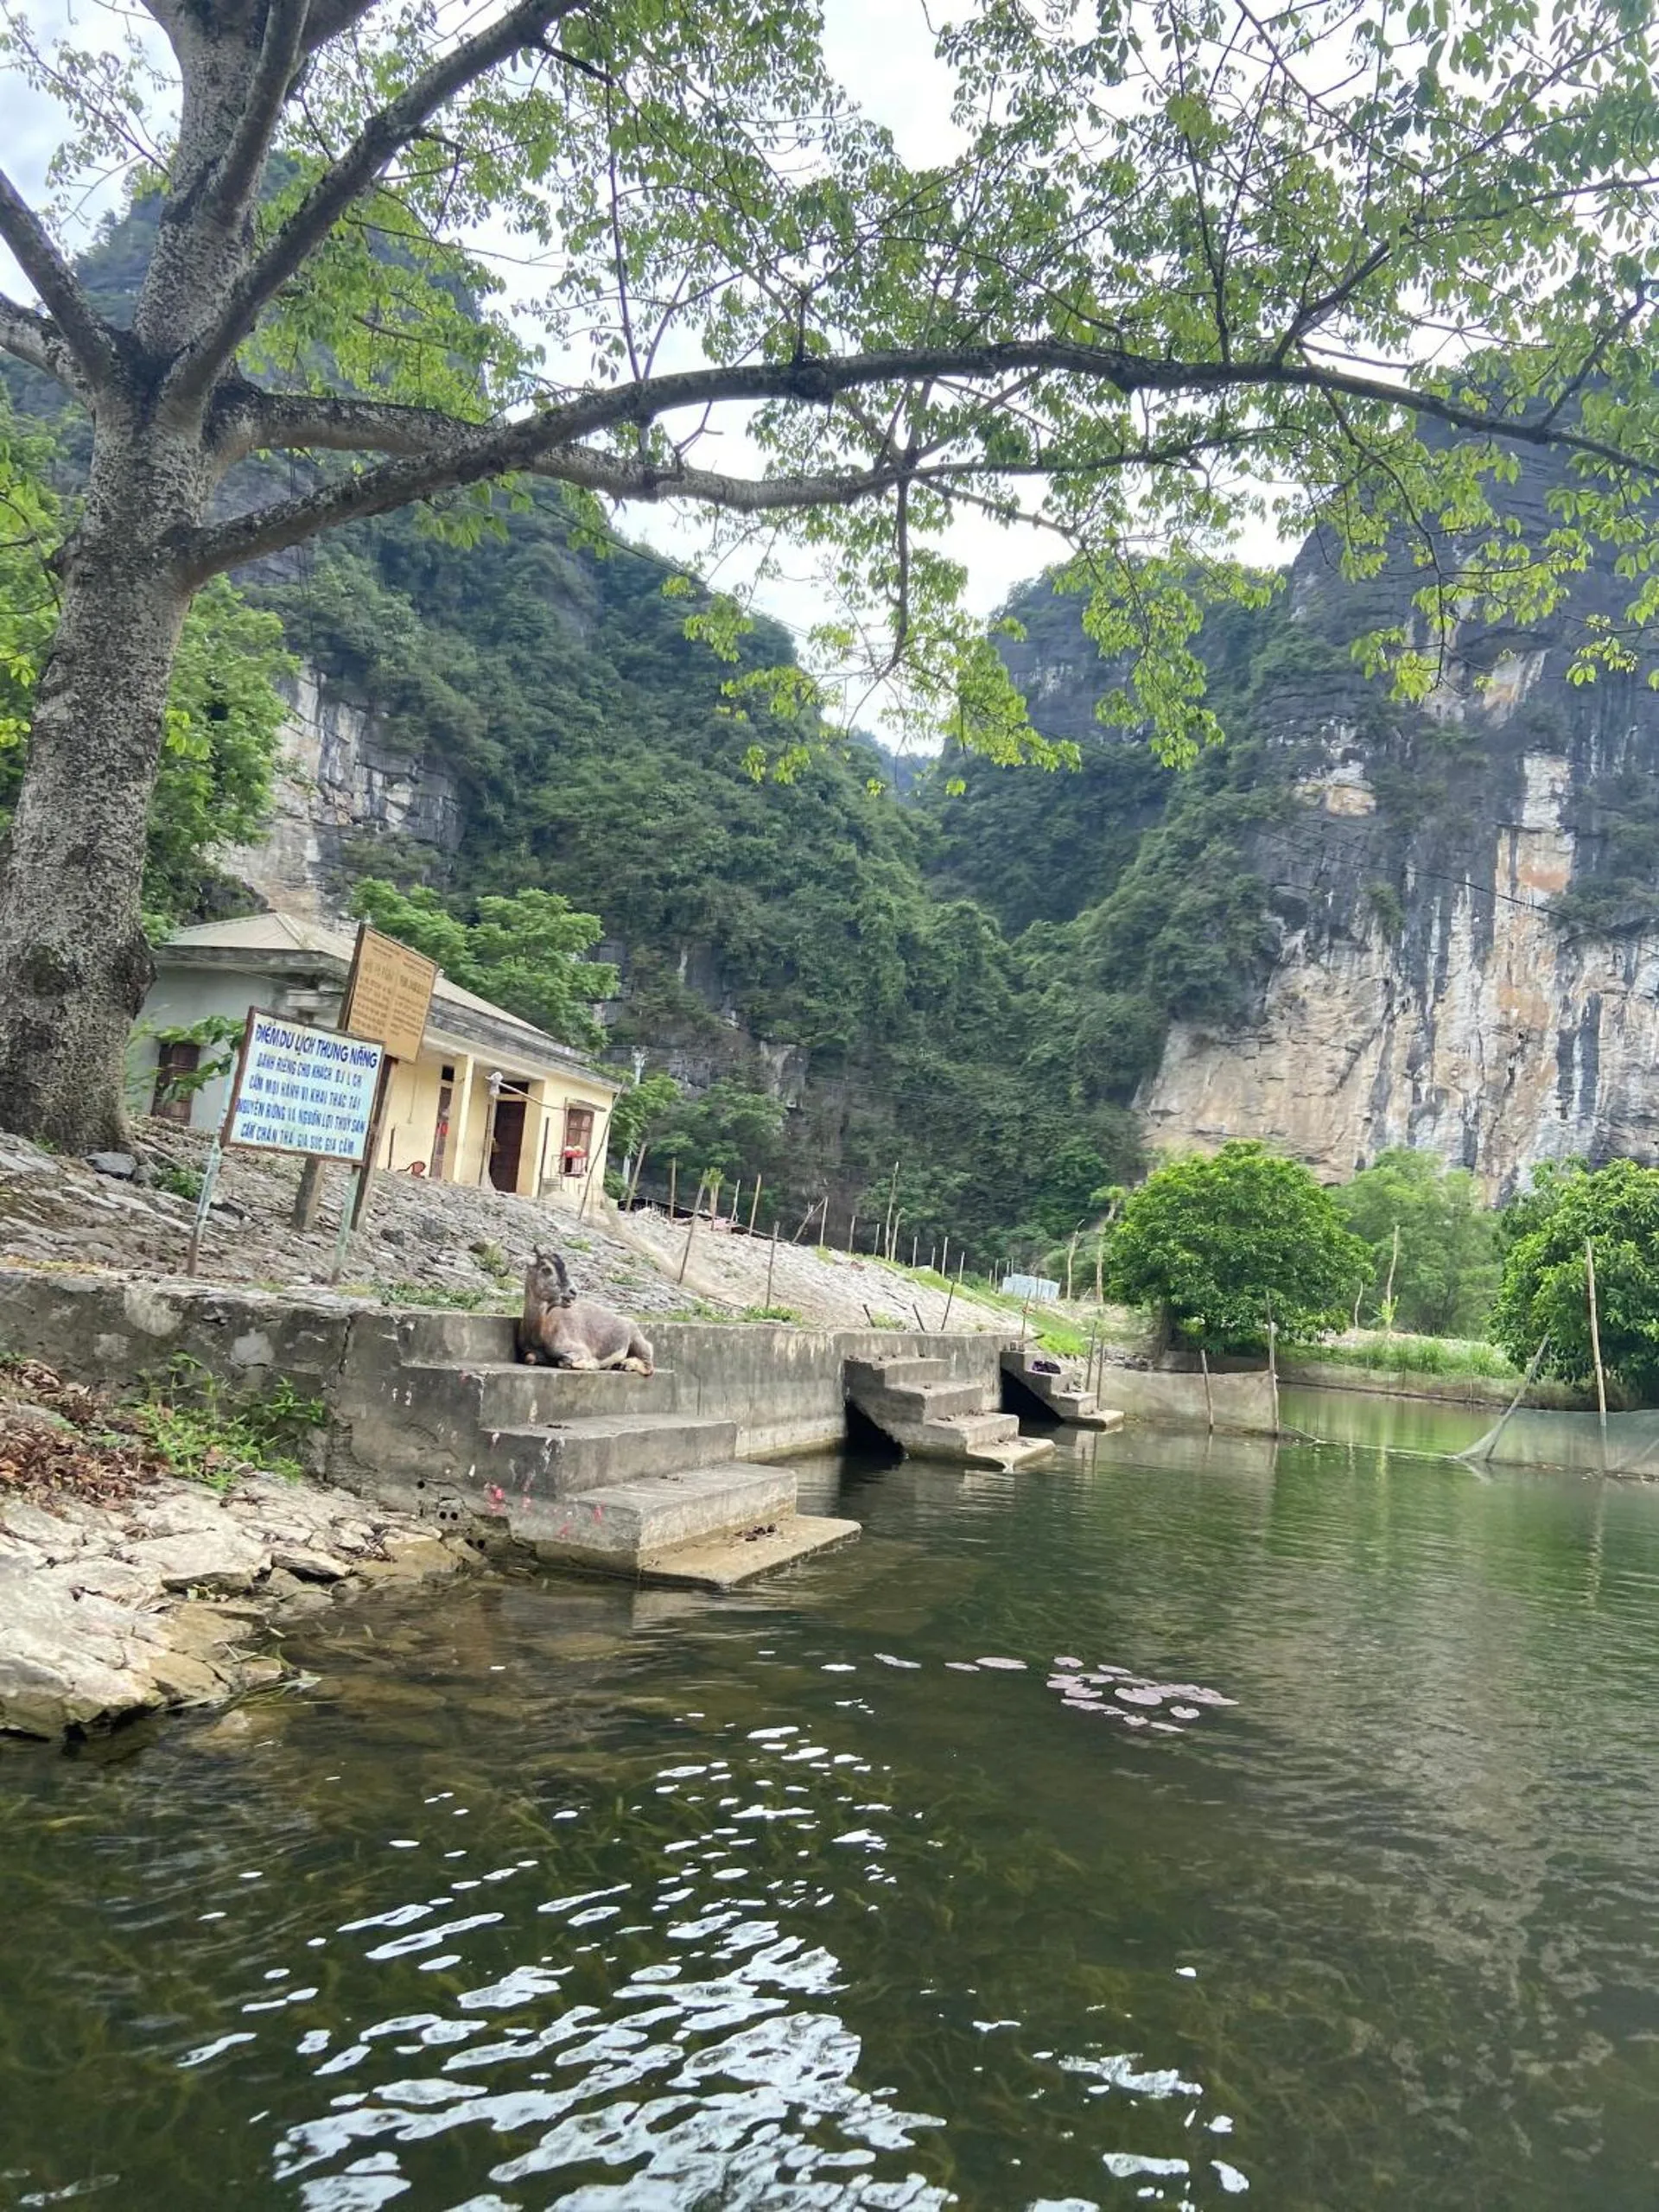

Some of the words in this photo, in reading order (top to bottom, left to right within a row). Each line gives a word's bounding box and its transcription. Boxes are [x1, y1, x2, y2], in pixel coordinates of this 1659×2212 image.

[279, 1030, 295, 1049] DU
[295, 1033, 316, 1056] LỊCH
[316, 1039, 348, 1062] THUNG
